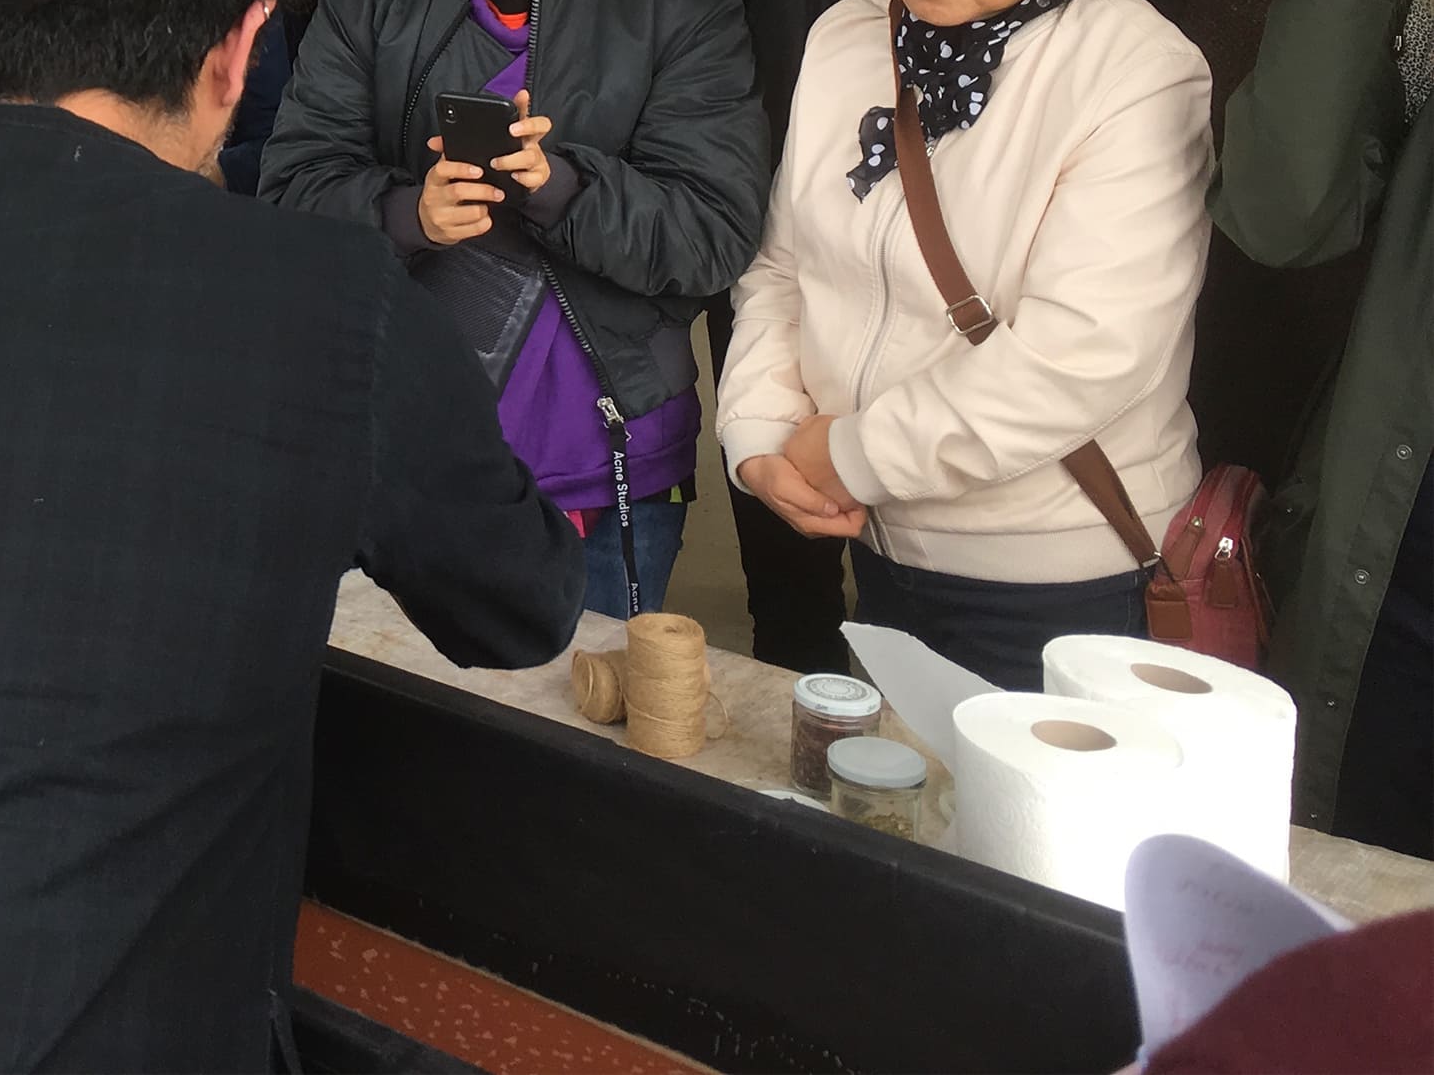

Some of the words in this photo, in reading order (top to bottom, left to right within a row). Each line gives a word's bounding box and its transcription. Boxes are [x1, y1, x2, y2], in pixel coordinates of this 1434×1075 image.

[613, 451, 625, 481] Acne
[616, 483, 631, 528] Studios
[630, 582, 639, 613] Acne
